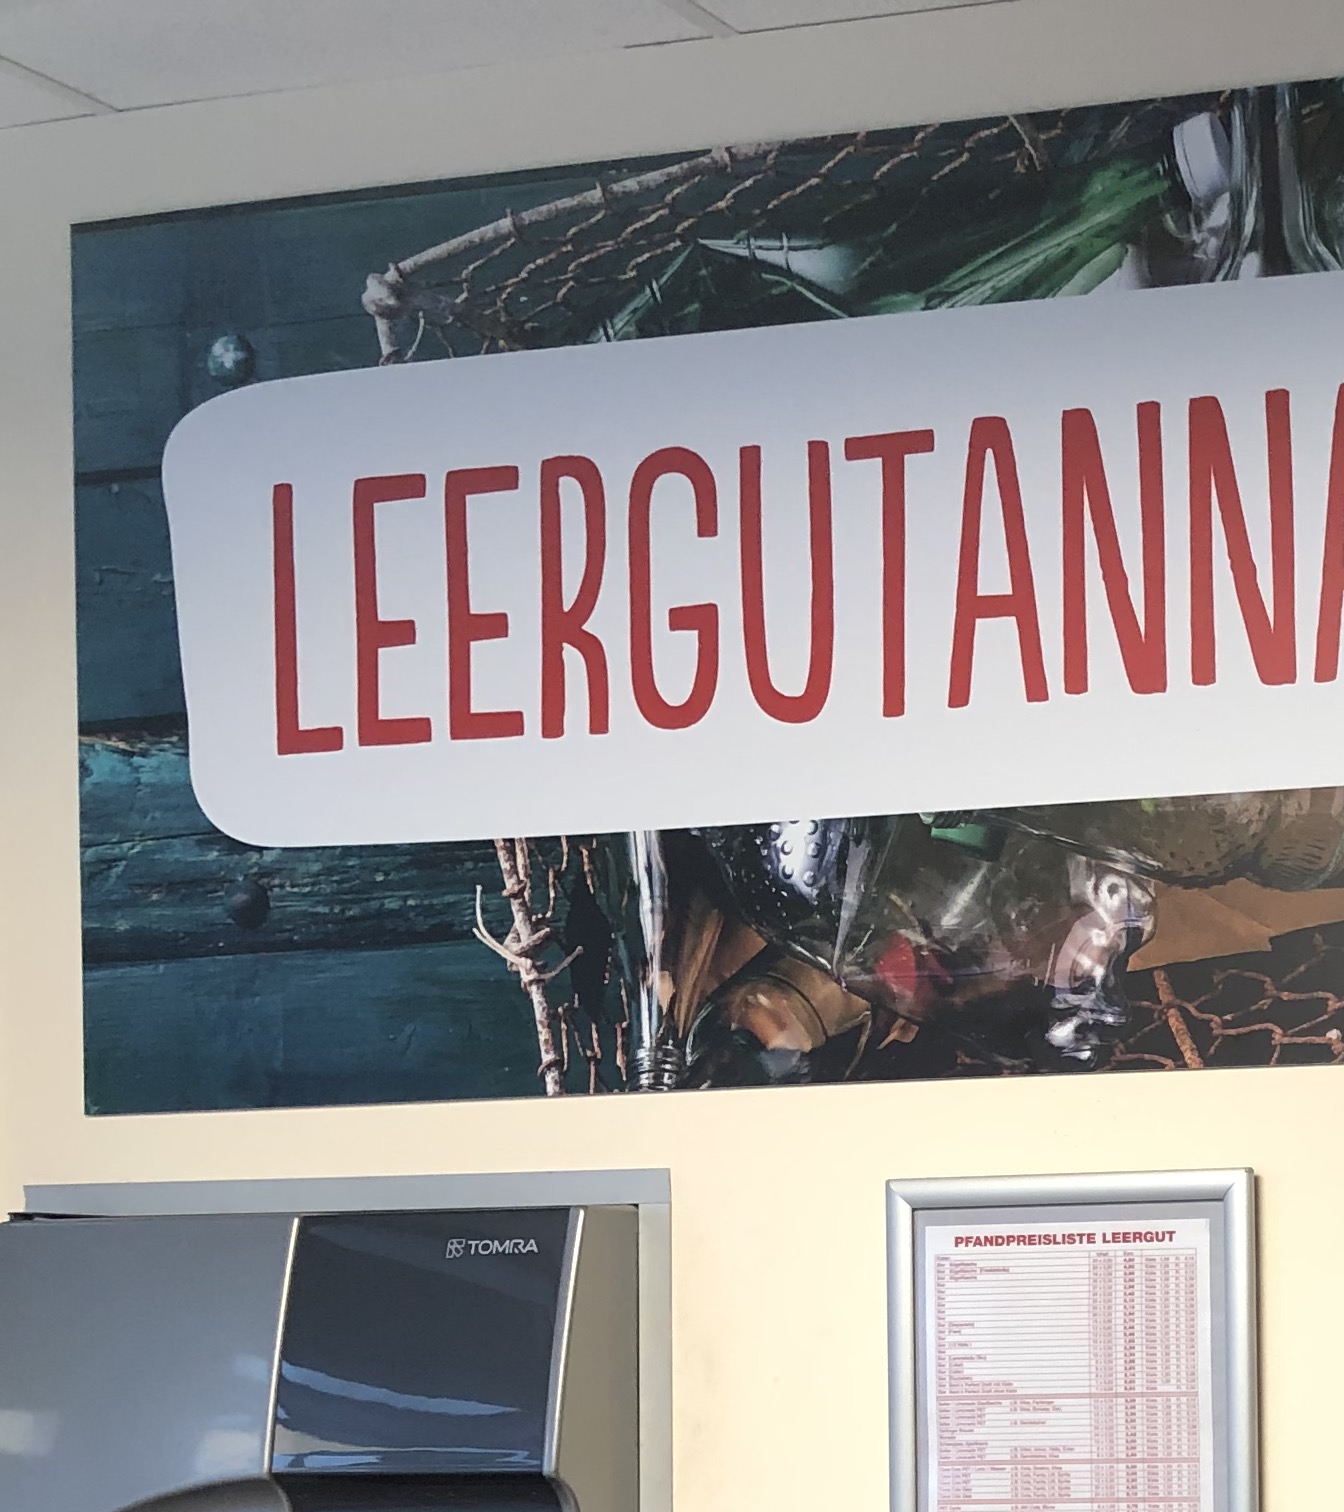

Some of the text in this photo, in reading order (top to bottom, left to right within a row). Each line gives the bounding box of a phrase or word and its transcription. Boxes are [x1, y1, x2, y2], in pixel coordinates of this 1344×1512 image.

[467, 1238, 539, 1255] TOMRA
[953, 1229, 1177, 1248] PFANDPREISLISTE LEERGUT
